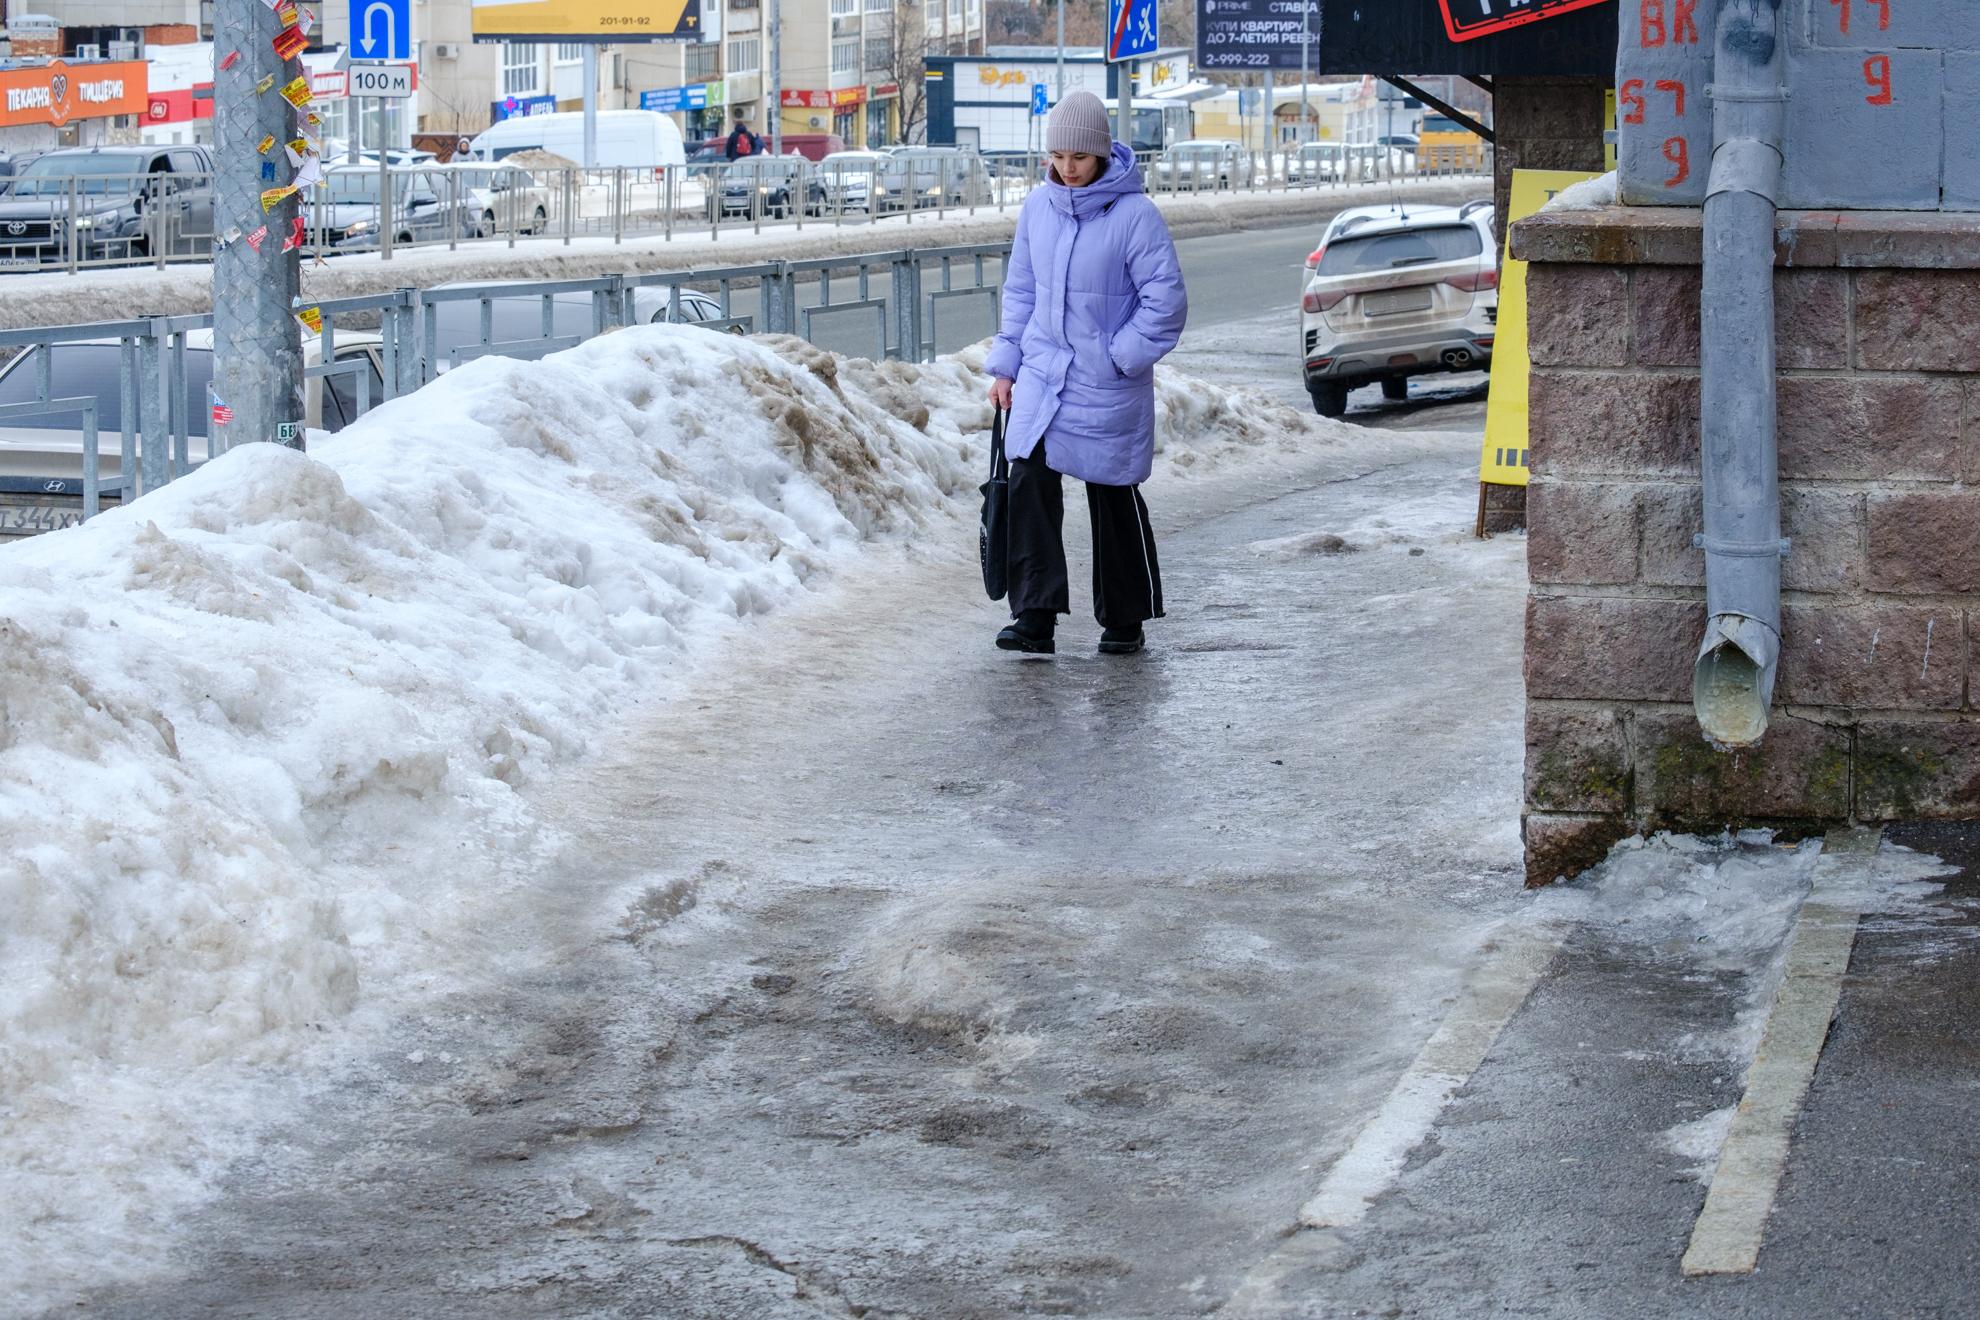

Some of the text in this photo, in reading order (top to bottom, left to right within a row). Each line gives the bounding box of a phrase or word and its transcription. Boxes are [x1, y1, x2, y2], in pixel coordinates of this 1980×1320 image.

[1270, 2, 1318, 13] СТАВА
[600, 16, 651, 25] 201-91-92
[1206, 21, 1304, 32] КУПИ КВАРТИРУ
[1206, 32, 1226, 44] ДО
[1228, 32, 1279, 44] 7-ЛЕТИЯ
[1206, 54, 1269, 65] 2-999-222
[355, 73, 388, 89] 100
[78, 79, 124, 105] ПИЦЦЕРИЯ
[7, 86, 50, 112] ПЕКАРНЯ
